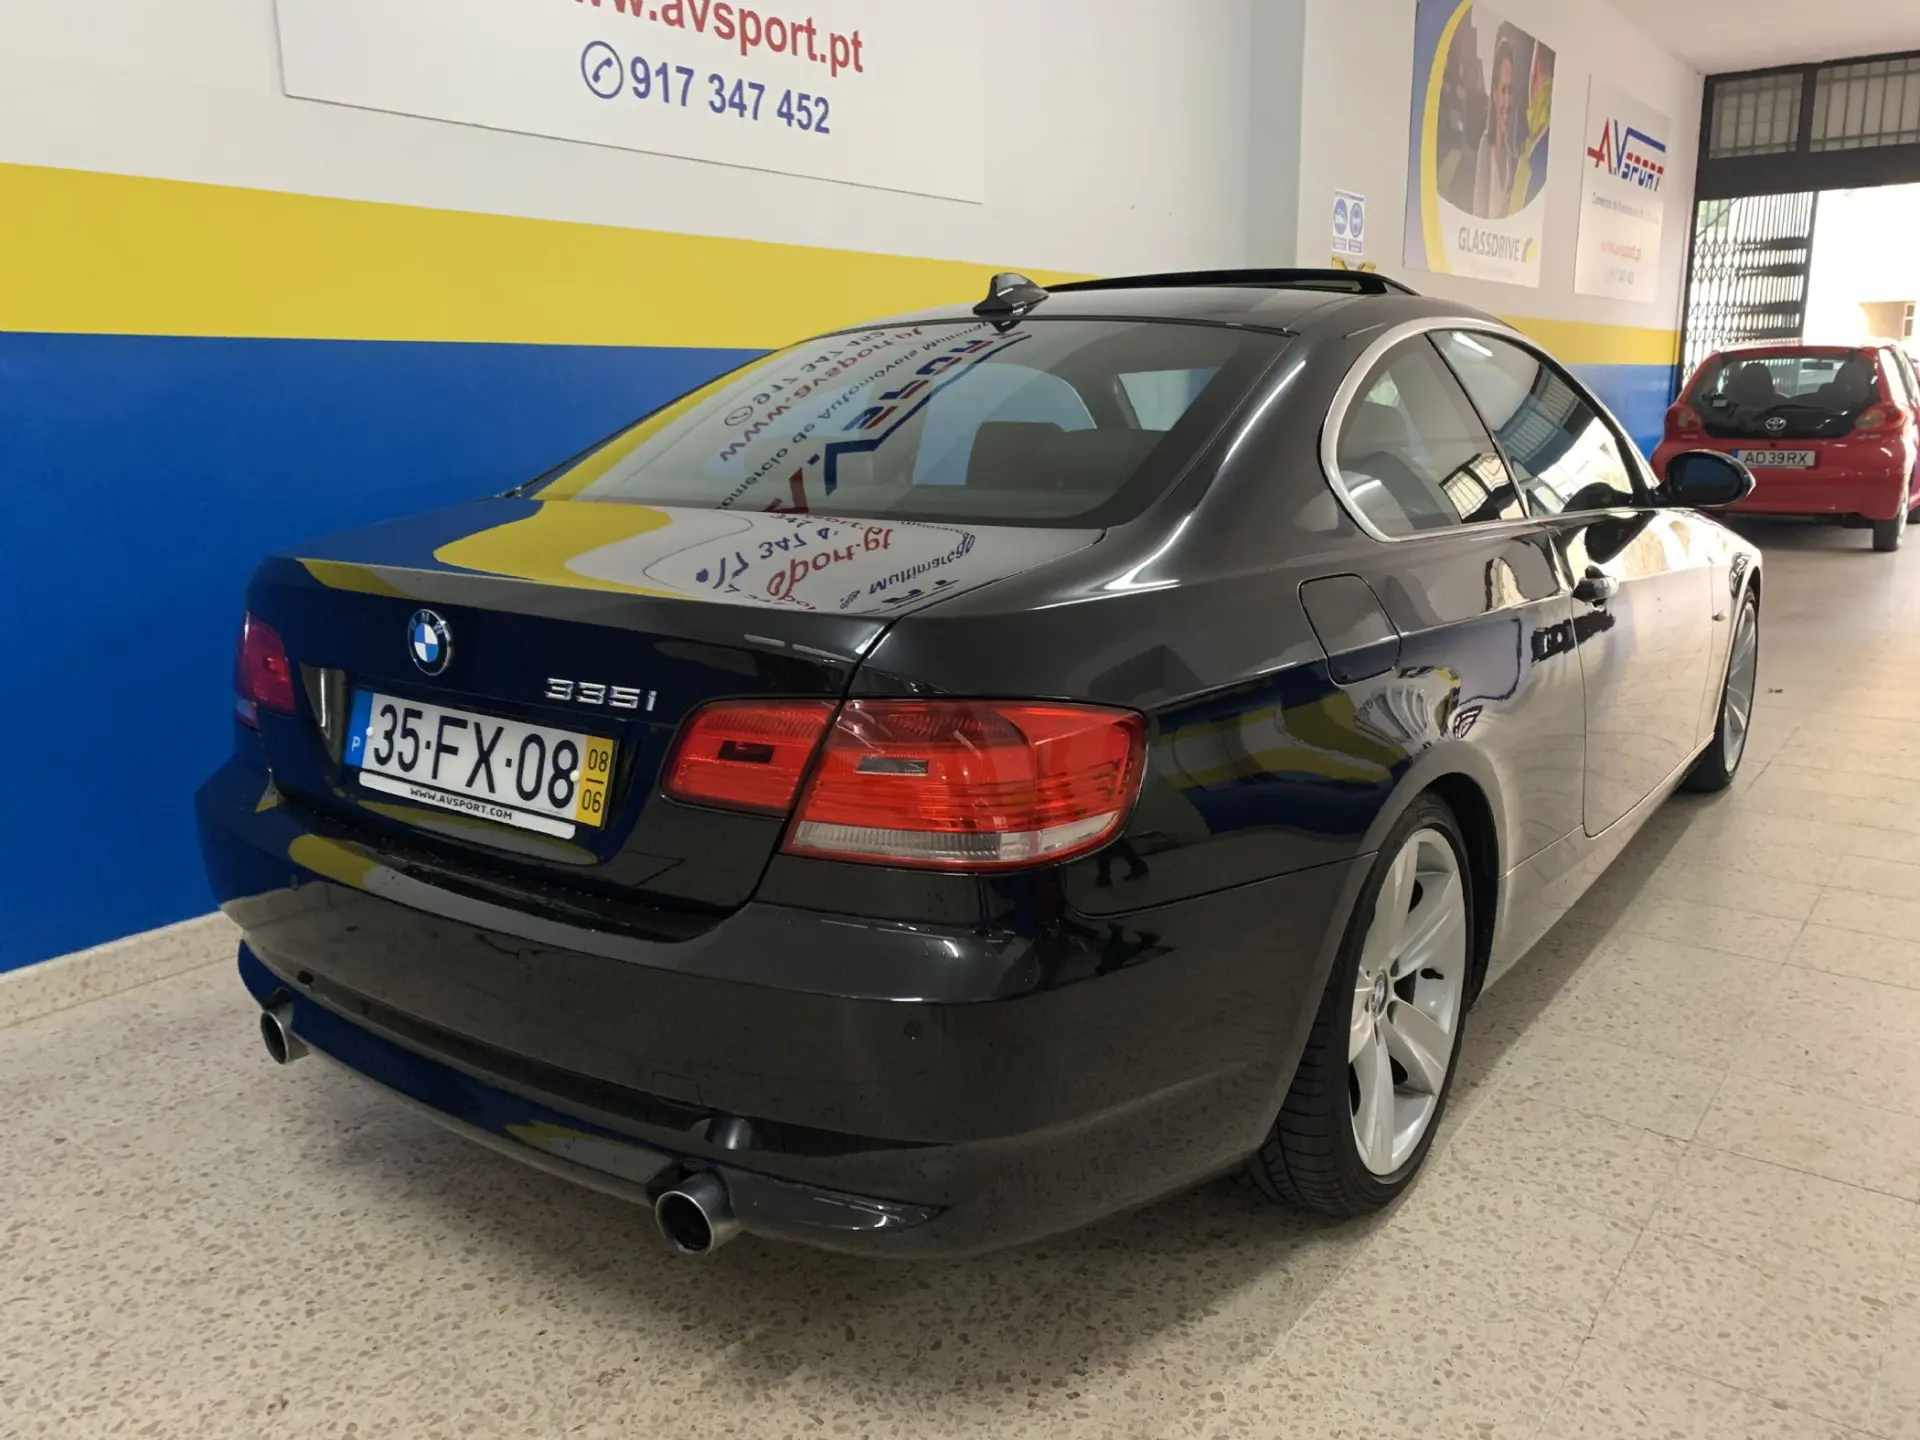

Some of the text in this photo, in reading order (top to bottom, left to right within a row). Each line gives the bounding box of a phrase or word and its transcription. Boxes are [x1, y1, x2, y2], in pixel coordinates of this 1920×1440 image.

[630, 56, 830, 134] 917 347 452
[1458, 226, 1520, 261] GLASSDRIVE
[351, 735, 361, 752] P
[588, 748, 609, 773] 08
[410, 787, 513, 820] WWW.AVSPORT.COM
[581, 789, 603, 814] 06
